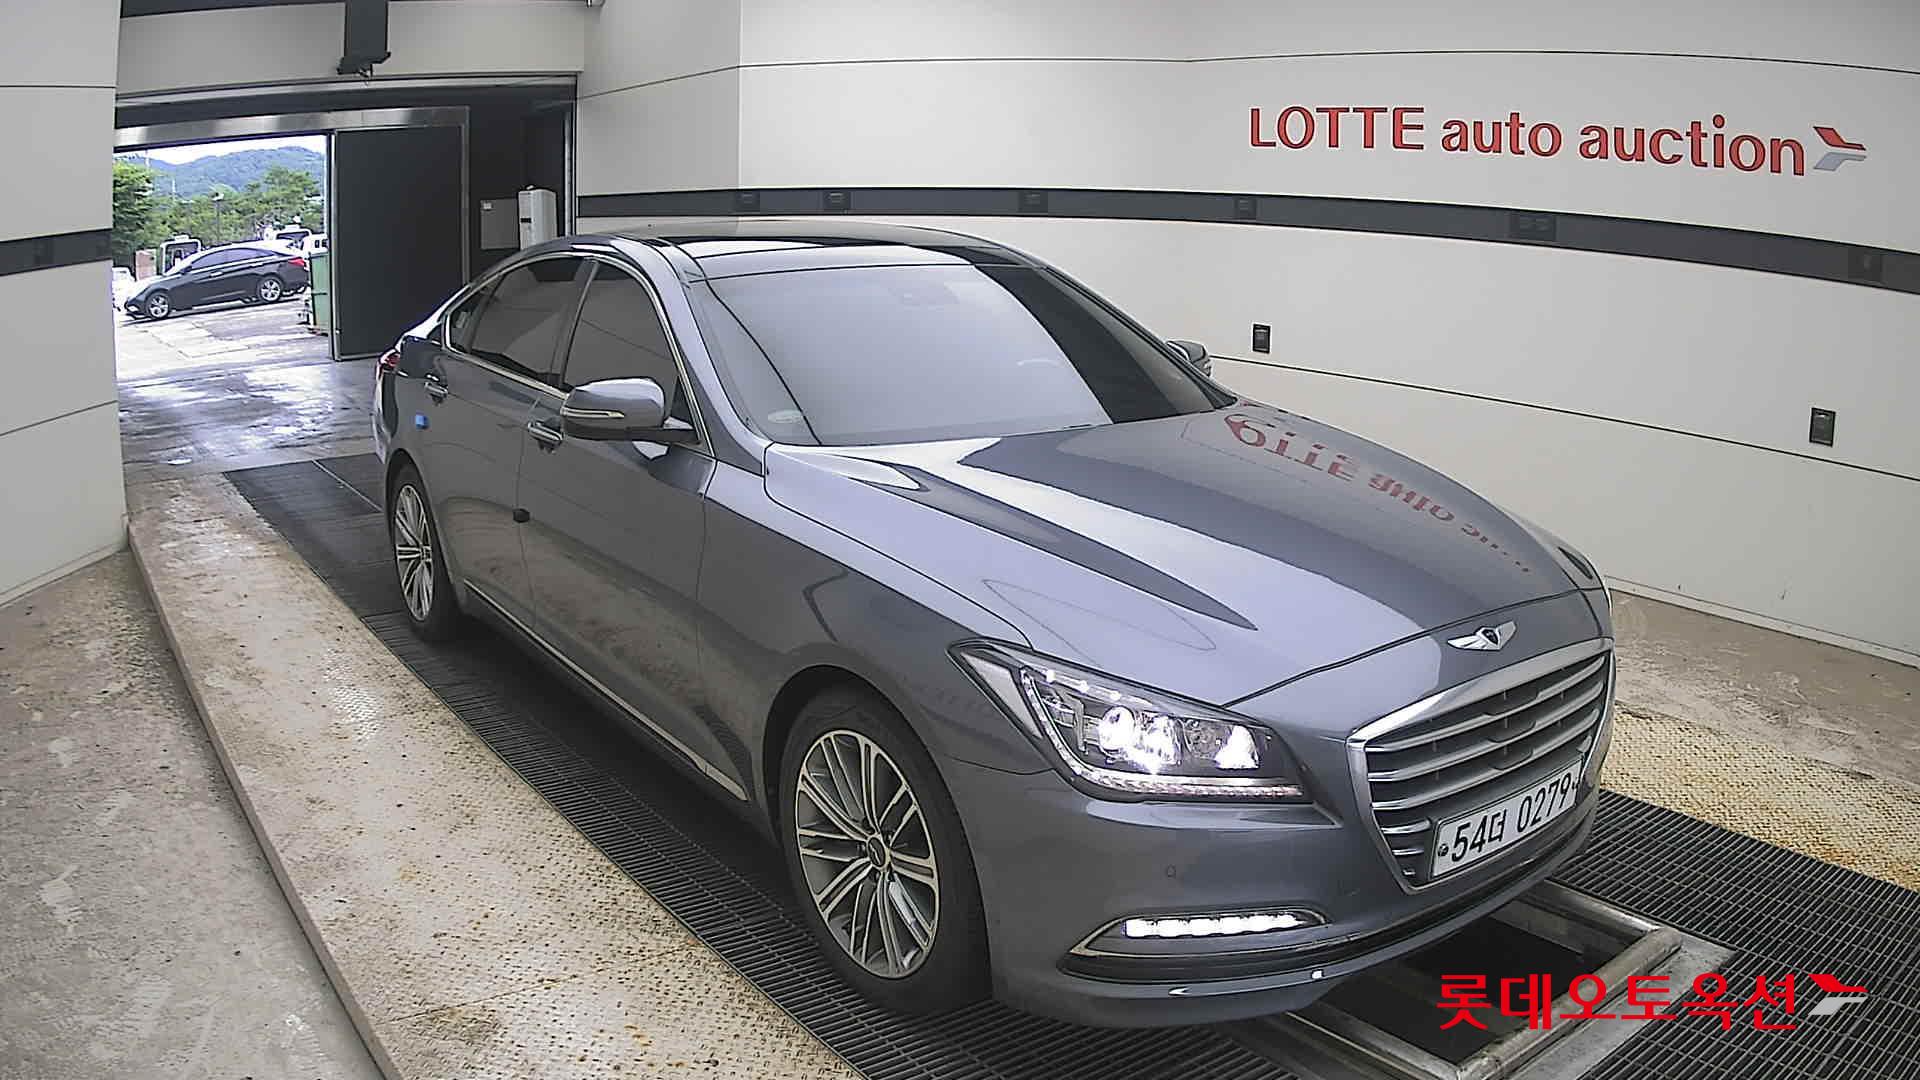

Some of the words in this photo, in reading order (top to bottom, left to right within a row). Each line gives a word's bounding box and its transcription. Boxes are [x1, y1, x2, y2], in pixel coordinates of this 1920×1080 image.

[1249, 105, 1425, 151] LOTTE
[1440, 111, 1563, 158] auto
[1577, 113, 1806, 178] auction
[1516, 772, 1572, 833] 0279
